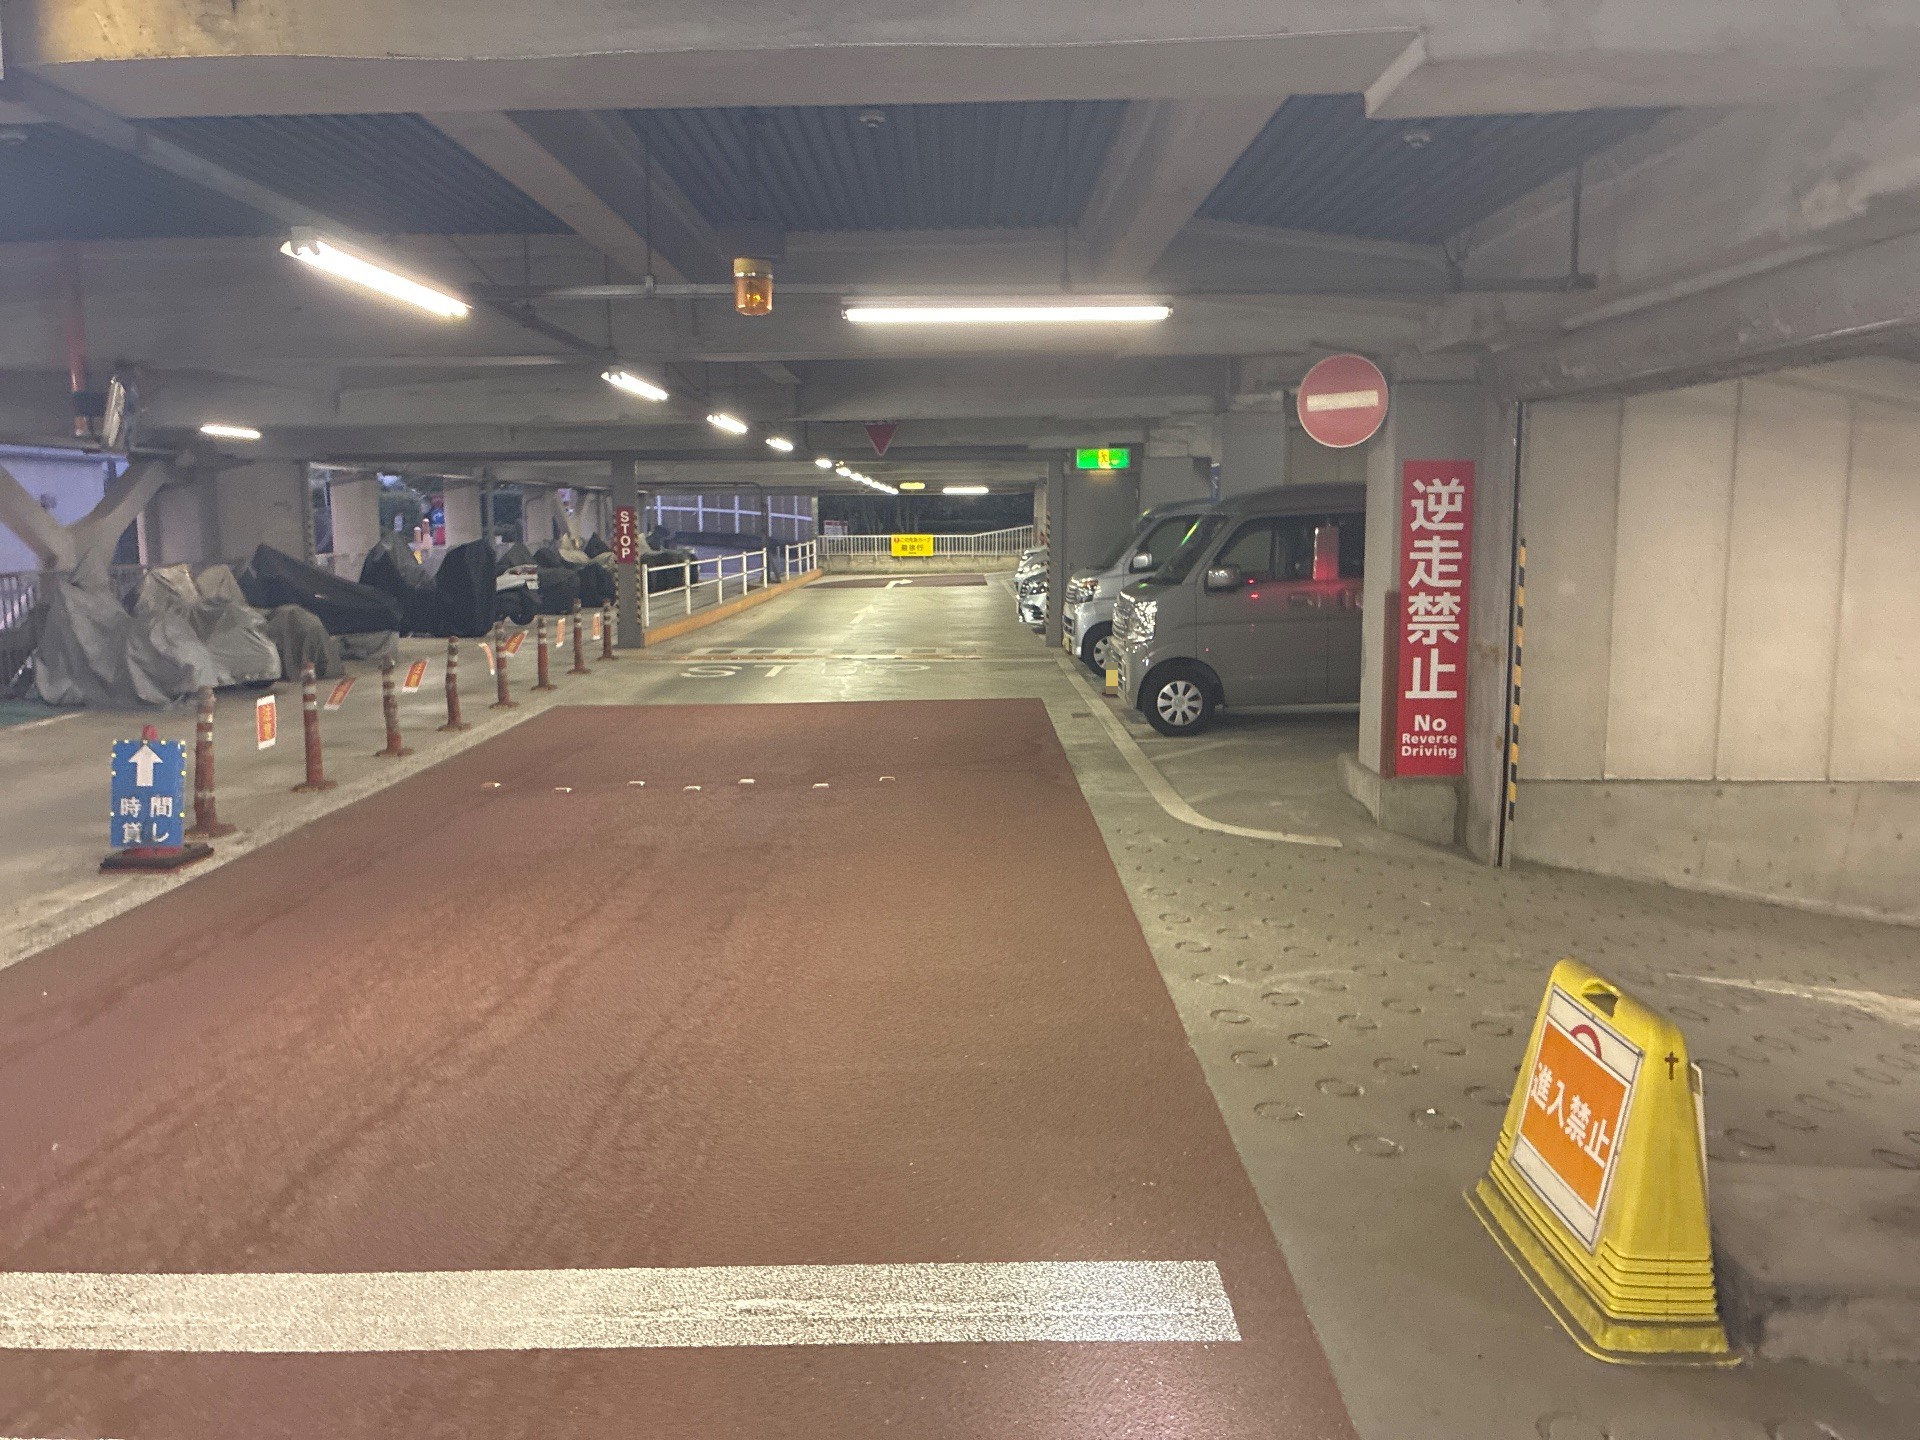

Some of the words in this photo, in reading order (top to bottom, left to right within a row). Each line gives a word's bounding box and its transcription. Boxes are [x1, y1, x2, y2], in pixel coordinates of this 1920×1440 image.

[620, 510, 631, 559] STOP
[1404, 477, 1465, 700] 逆走禁止
[1413, 714, 1447, 732] No
[1401, 732, 1458, 745] Reverse
[1401, 745, 1458, 760] Driving
[120, 796, 174, 818] 時間
[122, 822, 170, 843] 貸し
[1530, 1061, 1611, 1169] 進入禁止
